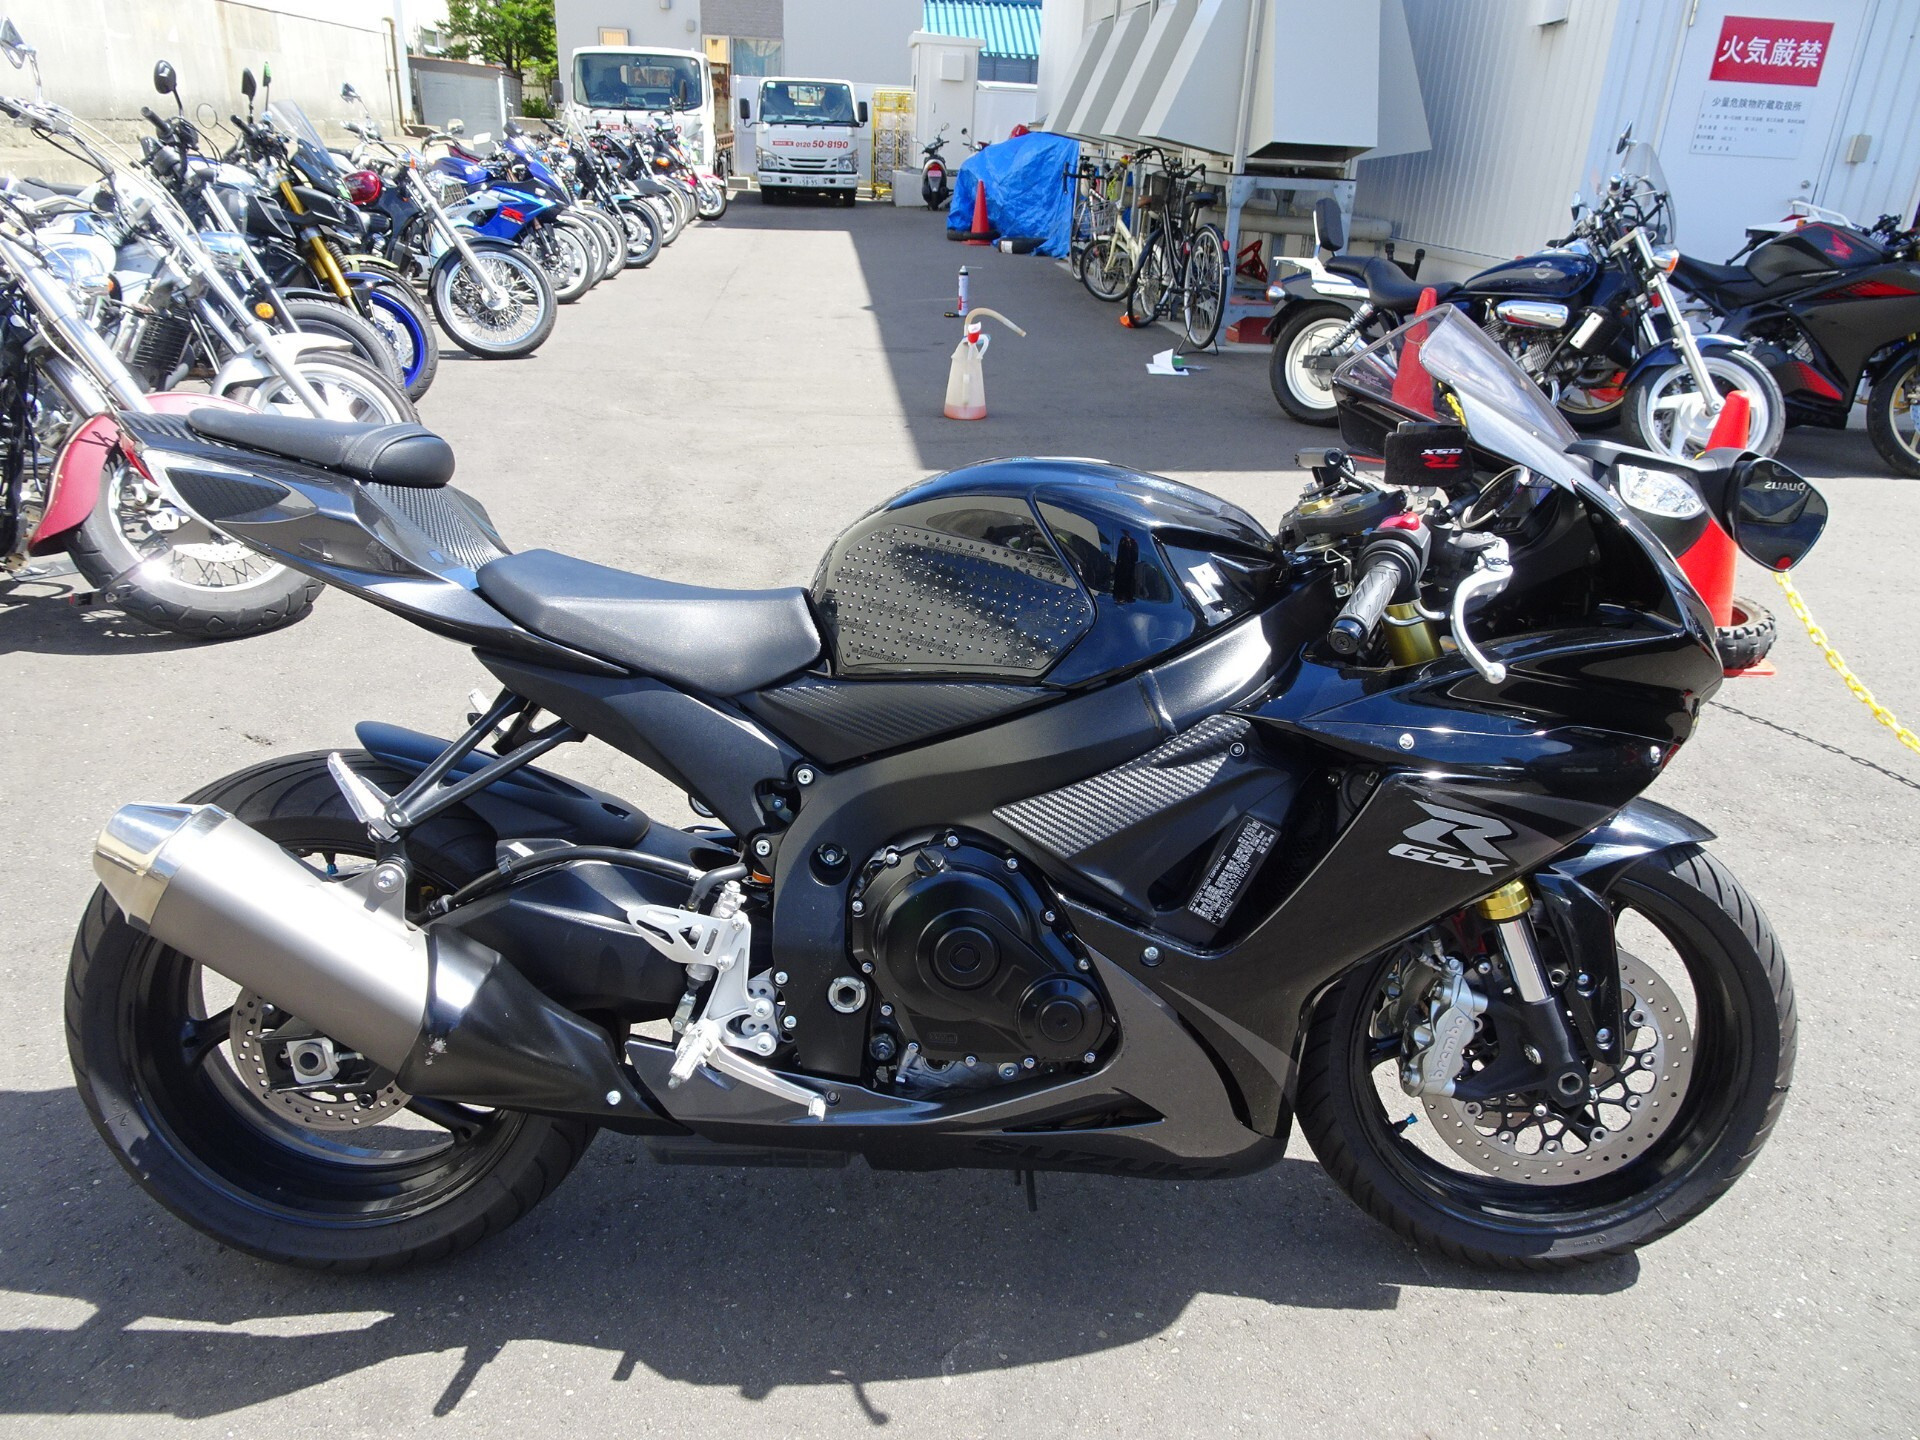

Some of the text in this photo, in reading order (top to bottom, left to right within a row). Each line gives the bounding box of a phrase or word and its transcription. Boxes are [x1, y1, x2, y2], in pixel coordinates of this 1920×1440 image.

[1718, 35, 1822, 68] 火気厳禁
[1402, 799, 1512, 861] R
[1388, 843, 1509, 875] GSX
[1429, 1015, 1464, 1080] brembo
